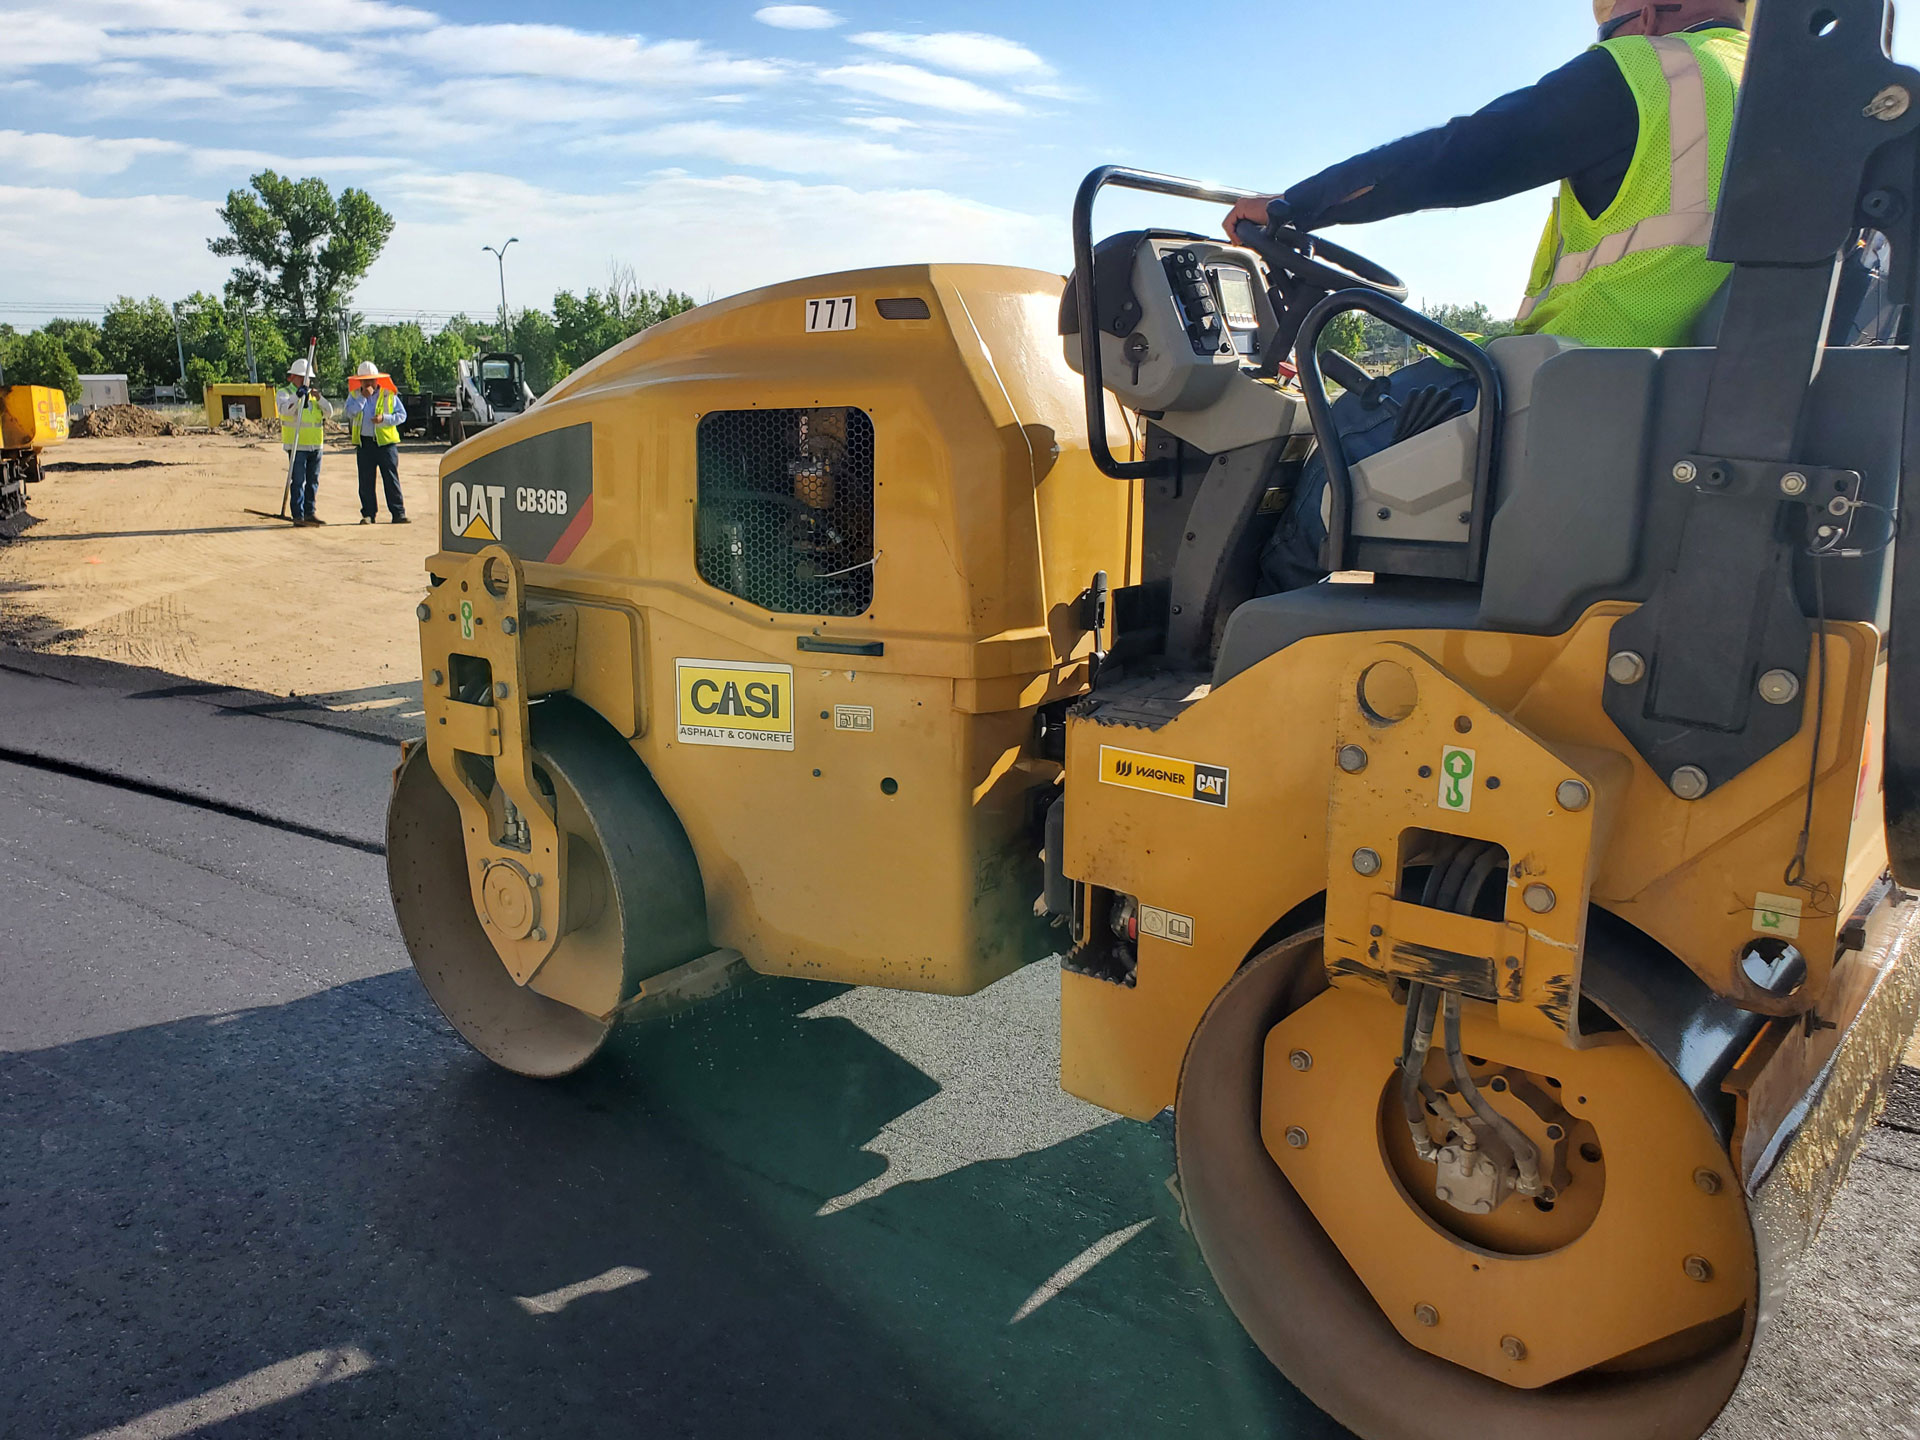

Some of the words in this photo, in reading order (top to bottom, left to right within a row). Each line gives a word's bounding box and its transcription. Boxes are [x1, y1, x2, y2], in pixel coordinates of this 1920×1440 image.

[809, 298, 852, 330] 777
[449, 482, 506, 541] CAT
[516, 486, 568, 515] CB36B
[691, 679, 780, 719] CASI
[680, 727, 724, 739] ASPHALT
[728, 731, 735, 739] &
[737, 731, 793, 743] CONCRETE
[1136, 766, 1185, 785] WAGNER
[1196, 774, 1225, 796] CAT
